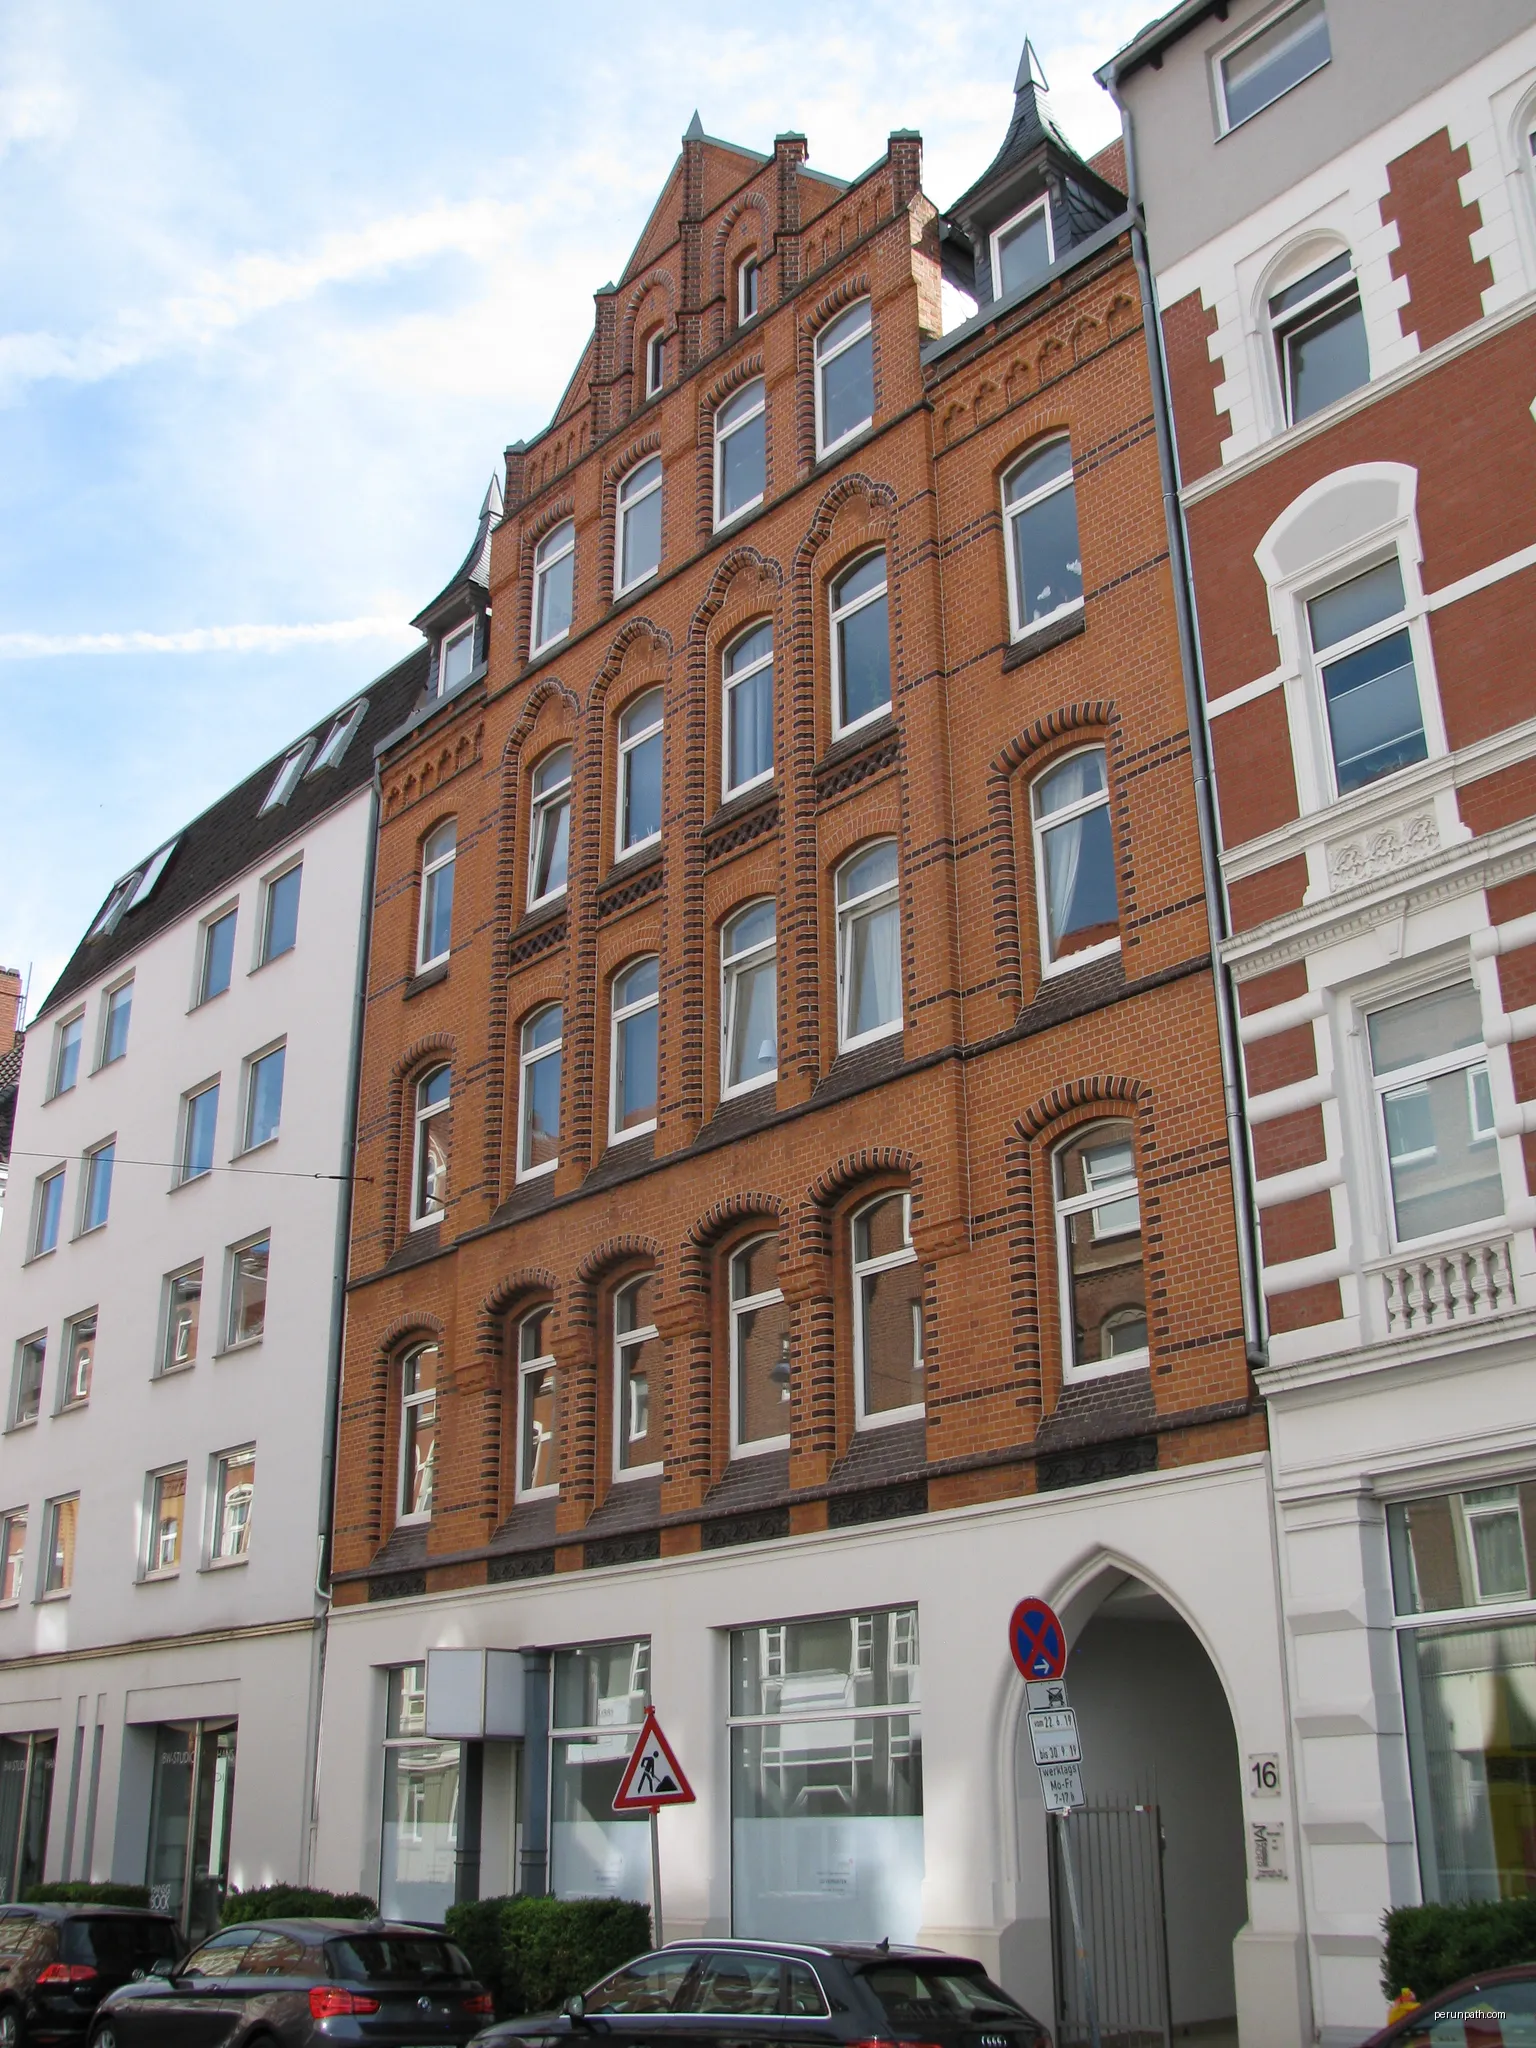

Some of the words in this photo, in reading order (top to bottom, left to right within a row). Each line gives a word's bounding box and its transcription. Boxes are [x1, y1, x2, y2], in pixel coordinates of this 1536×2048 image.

[1039, 1748, 1048, 1760] bis
[1043, 1764, 1077, 1777] werktags
[1252, 1761, 1277, 1788] 16
[1050, 1778, 1073, 1791] Mo-Fr
